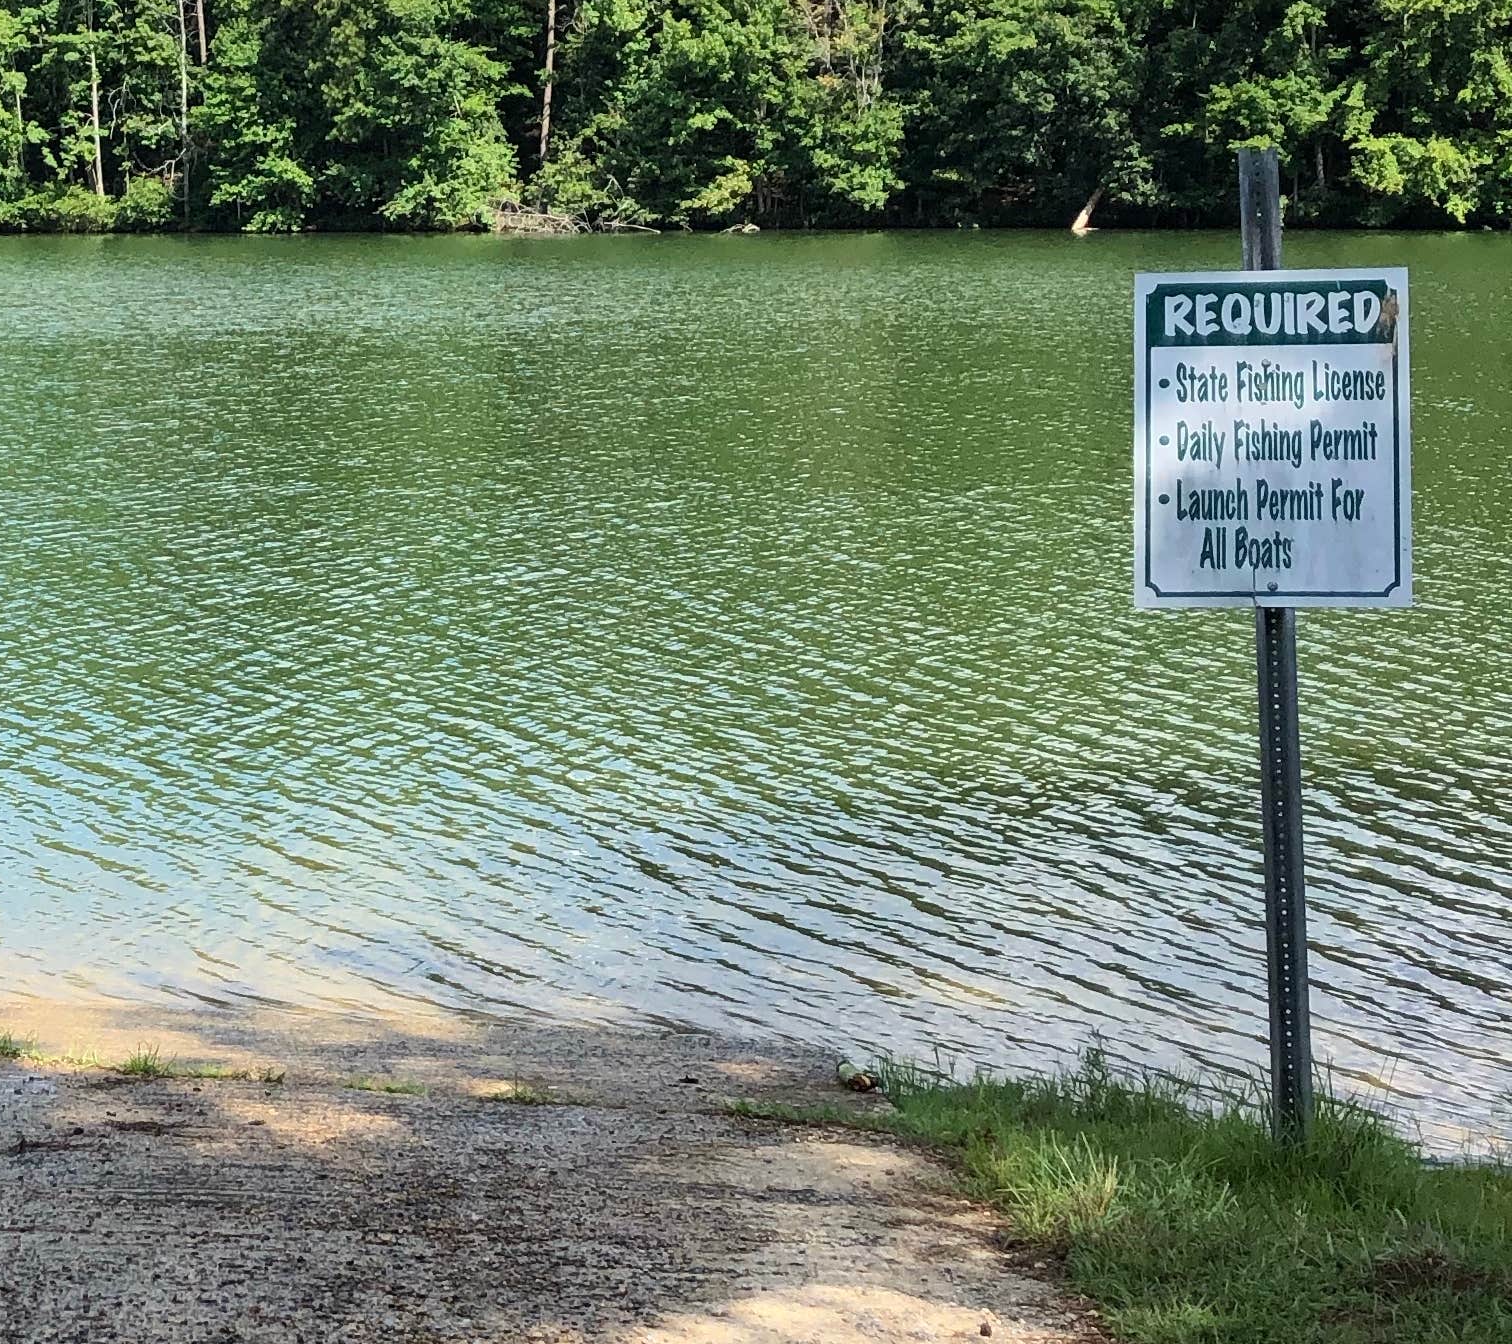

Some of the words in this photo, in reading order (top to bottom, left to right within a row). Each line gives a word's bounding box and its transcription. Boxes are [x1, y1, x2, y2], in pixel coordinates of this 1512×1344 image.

[1163, 290, 1381, 337] REQUIRED
[1176, 361, 1228, 403] State
[1236, 360, 1305, 409] Fishing
[1312, 360, 1386, 401] License
[1176, 420, 1226, 469] Daily
[1233, 419, 1303, 468] Fishing
[1310, 419, 1378, 461] Permit
[1176, 478, 1249, 521] Launch
[1256, 478, 1324, 521] Permit
[1331, 478, 1365, 521] For
[1199, 526, 1227, 569] All
[1234, 526, 1293, 570] Boats
